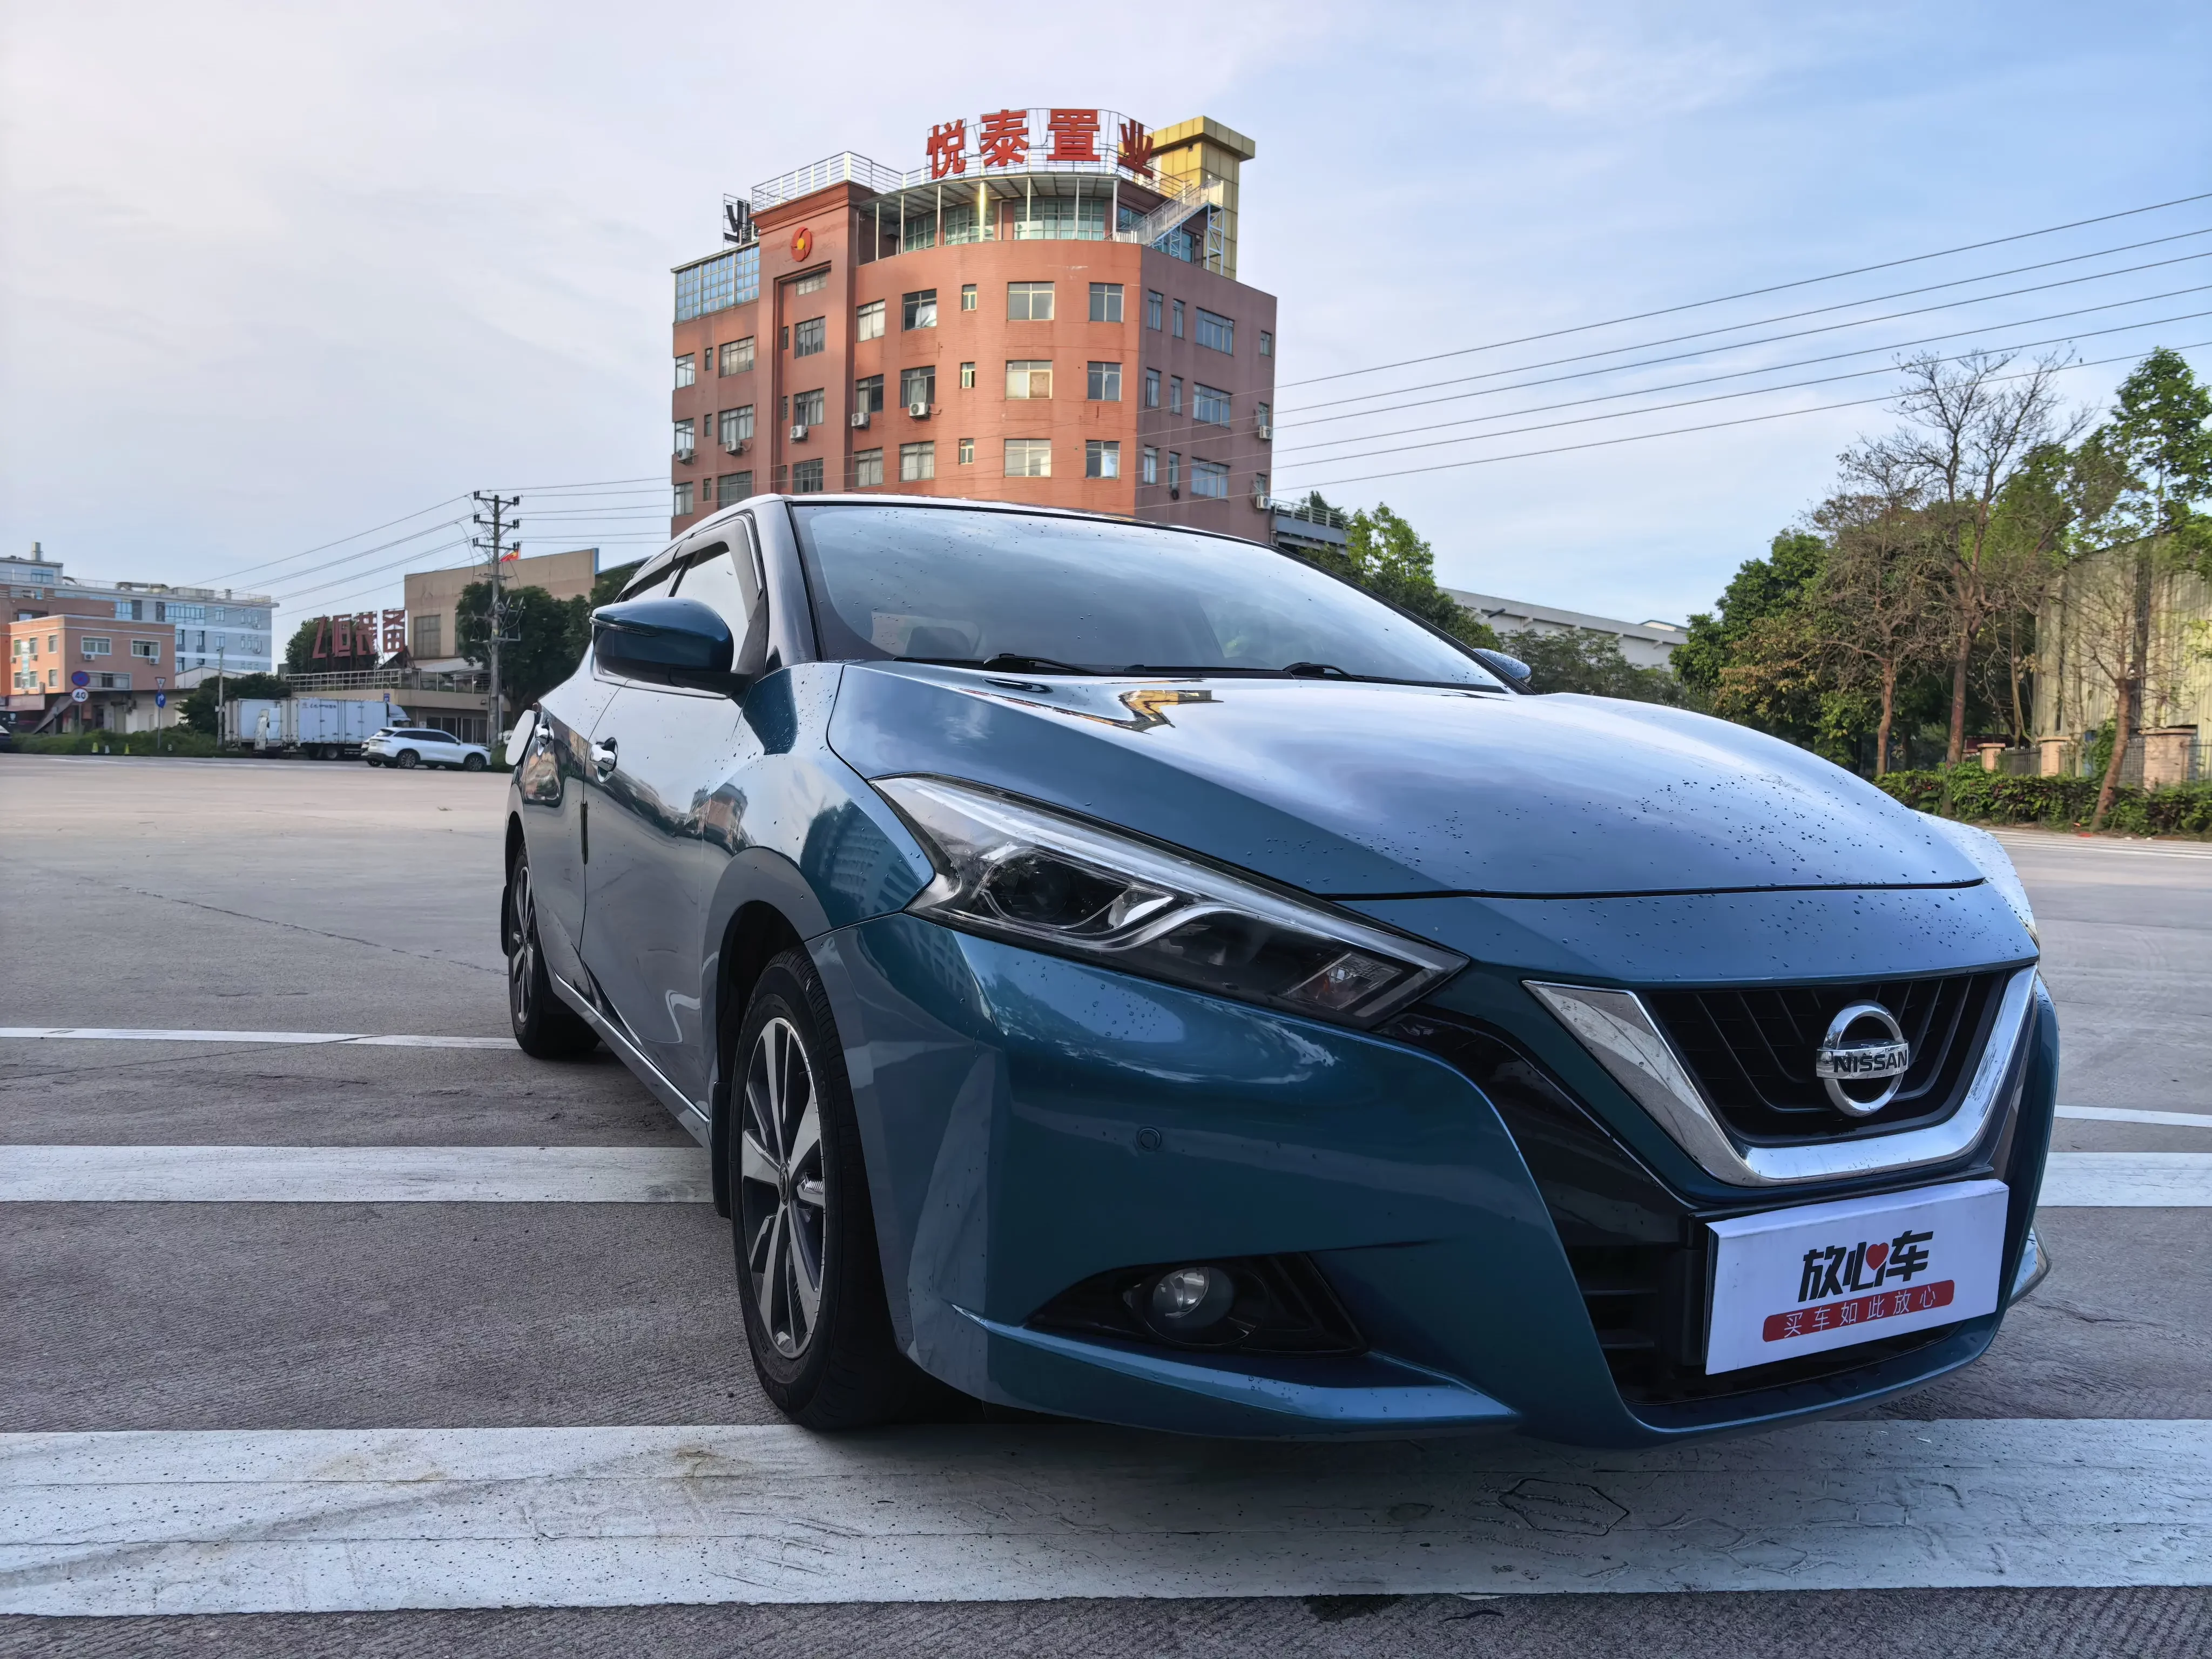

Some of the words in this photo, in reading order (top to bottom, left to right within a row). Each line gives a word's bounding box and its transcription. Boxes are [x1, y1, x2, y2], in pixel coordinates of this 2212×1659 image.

[926, 109, 1154, 180] 悦泰置业
[1833, 1051, 1907, 1073] NISSAN
[1798, 1230, 1934, 1303] 放心车
[1784, 1285, 1936, 1338] 买车如此放心
